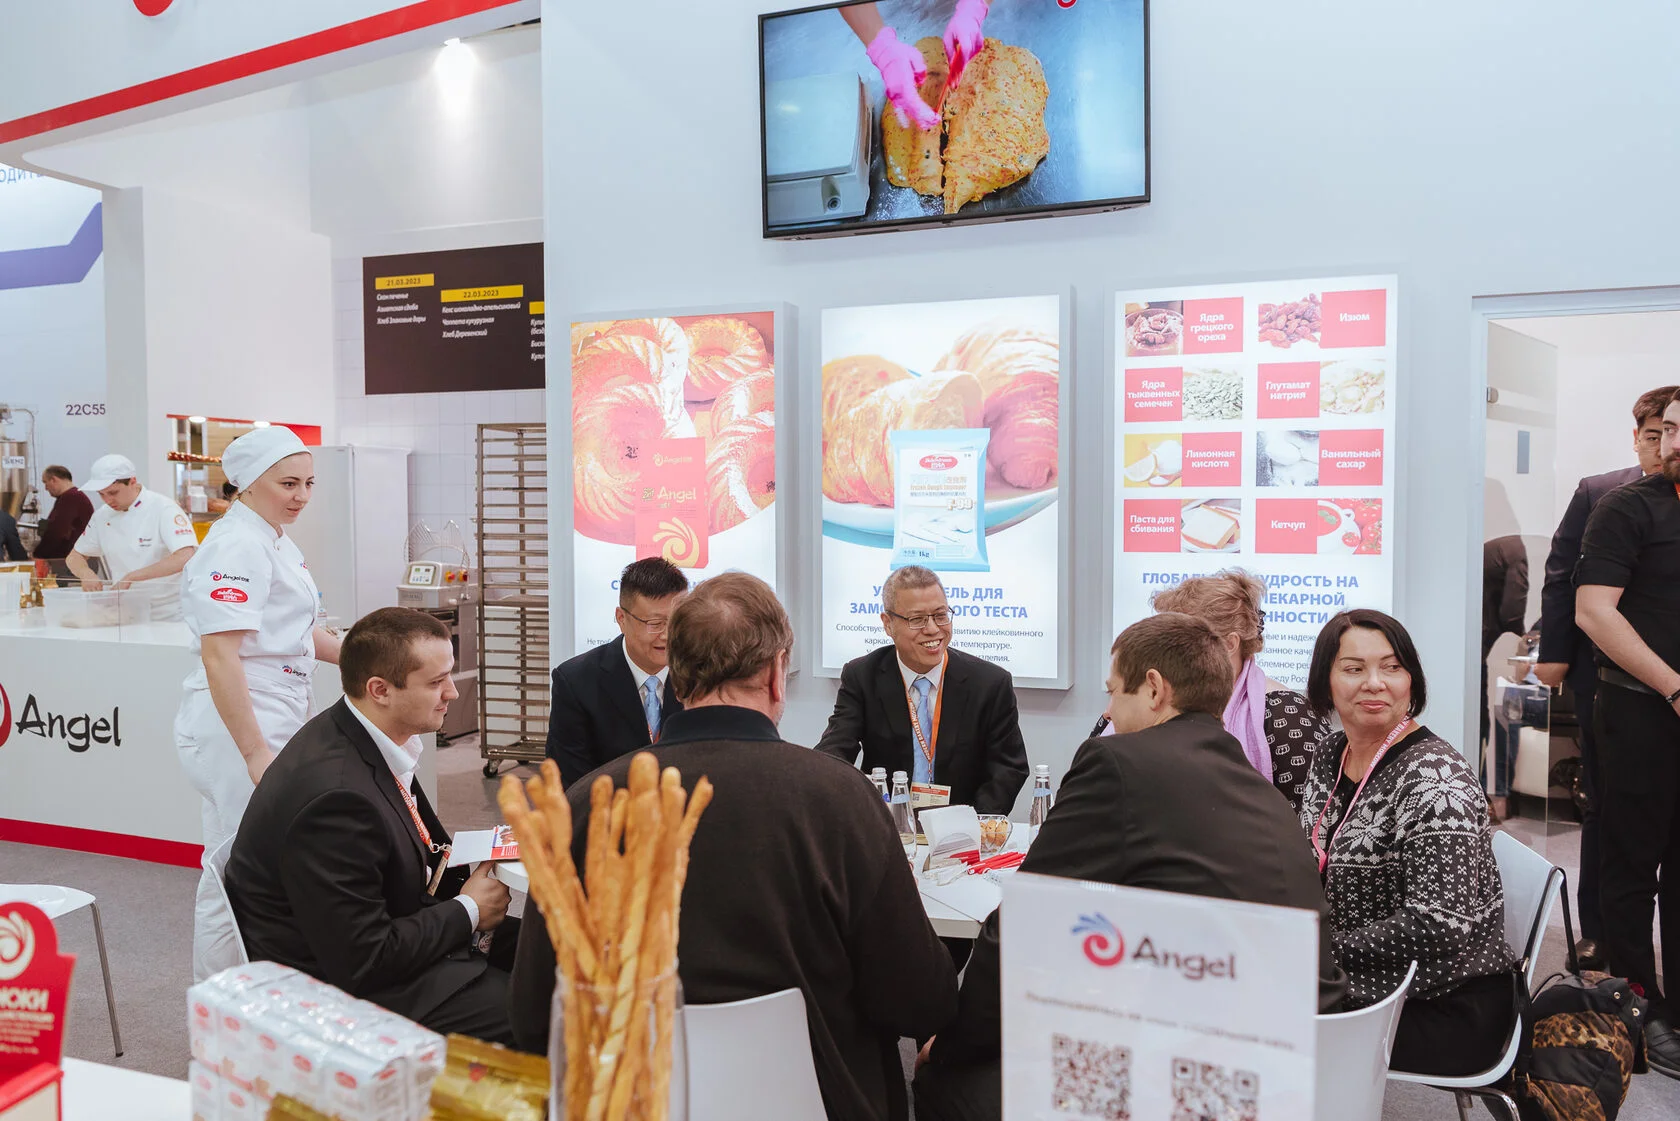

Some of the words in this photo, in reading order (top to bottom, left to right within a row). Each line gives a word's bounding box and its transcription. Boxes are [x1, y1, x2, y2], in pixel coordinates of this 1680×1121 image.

[387, 278, 421, 287] 21.03.2023
[463, 289, 499, 298] 22.03.2023
[1199, 313, 1225, 323] Ядра
[1339, 312, 1370, 322] Изюм
[1190, 322, 1234, 334] грецкого
[1197, 333, 1226, 343] ореха
[1141, 380, 1166, 390] Ядра
[1265, 381, 1311, 391] Глутамат
[1127, 389, 1180, 399] тыквенных
[1269, 390, 1306, 401] натрия
[1134, 399, 1173, 408] семечек
[65, 404, 106, 416] 22C55
[1185, 449, 1235, 459] Лимонная
[1321, 449, 1381, 459] Ванильный
[1191, 459, 1229, 468] кислота
[1335, 460, 1366, 471] сахар
[658, 486, 697, 503] Angel
[1130, 514, 1156, 524] Паста
[1157, 515, 1175, 526] для
[1271, 519, 1306, 530] Кетчуп
[1130, 524, 1174, 533] сбивания
[1336, 575, 1359, 588] НА
[972, 588, 1003, 600] ДЛЯ
[986, 605, 1028, 618] ТЕСТА
[952, 628, 981, 636] звитию
[981, 628, 1044, 638] клейковинного
[960, 641, 1013, 651] температуре.
[15, 693, 121, 753] Angel
[1369, 743, 1388, 767] MOSCOW
[1132, 936, 1237, 981] Angel
